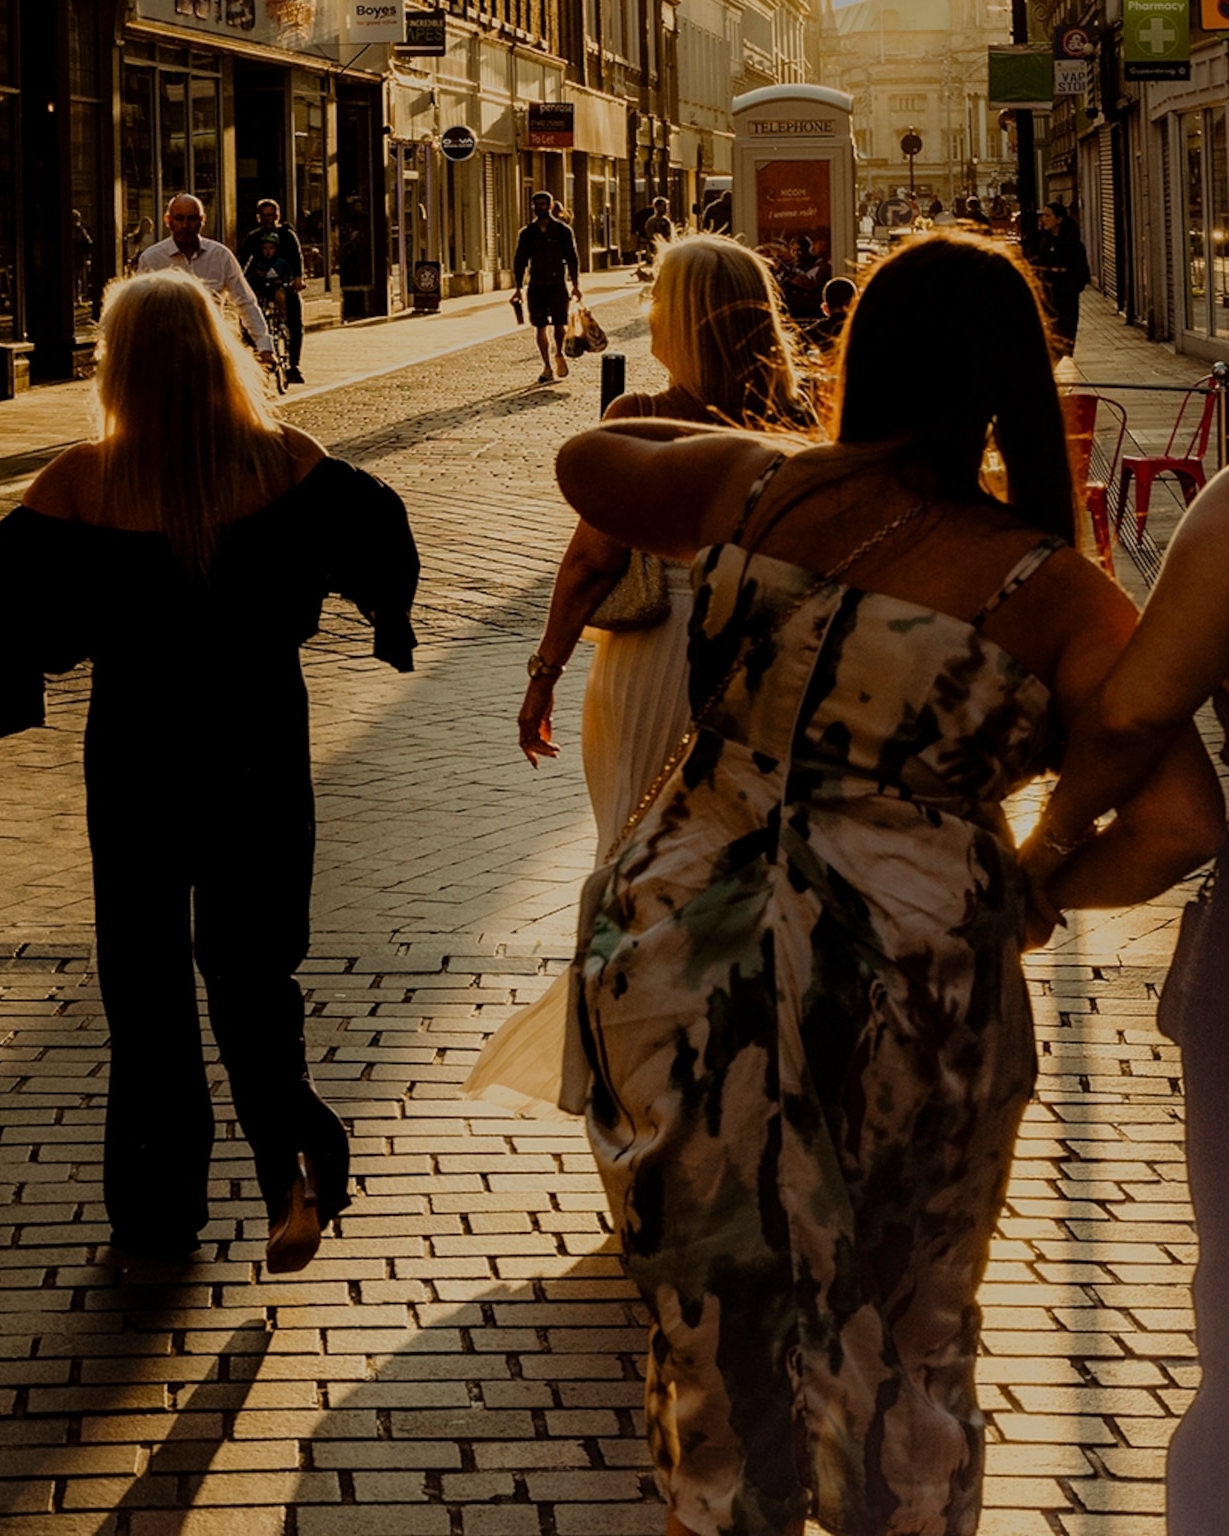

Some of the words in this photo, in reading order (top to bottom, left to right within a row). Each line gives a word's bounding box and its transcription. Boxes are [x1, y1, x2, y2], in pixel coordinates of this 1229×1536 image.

[356, 5, 397, 19] Boyes
[1127, 0, 1186, 13] Pharmacy
[752, 120, 833, 133] TELEPHONE
[531, 134, 541, 144] To
[542, 134, 555, 144] Let
